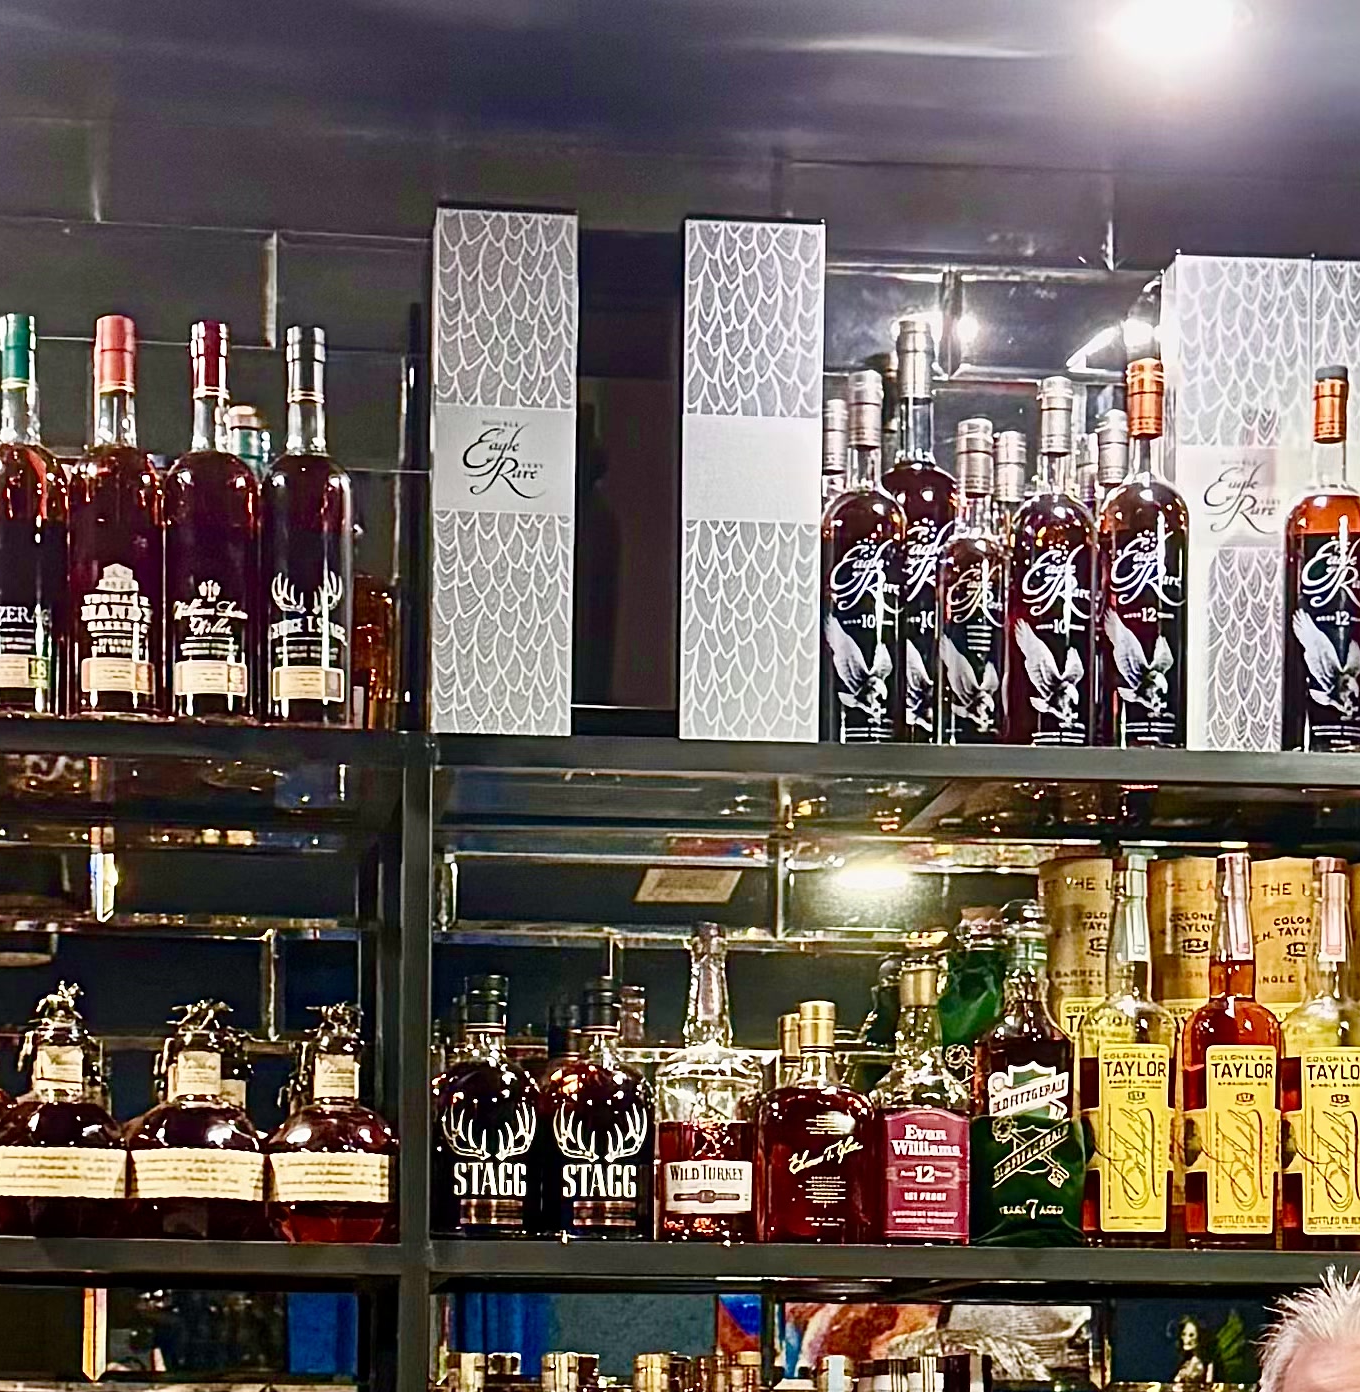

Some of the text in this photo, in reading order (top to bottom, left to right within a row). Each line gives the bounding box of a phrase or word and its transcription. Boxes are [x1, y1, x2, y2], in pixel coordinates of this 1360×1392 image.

[462, 422, 530, 477] Eagle
[470, 457, 546, 499] Rare
[1210, 495, 1279, 535] Rare
[860, 611, 877, 628] 10
[1140, 607, 1158, 623] 12
[1334, 610, 1350, 626] 12
[1261, 882, 1293, 897] THE
[1169, 911, 1216, 922] COLONE
[1081, 921, 1108, 931] TAYL
[1278, 926, 1312, 937] TAYL
[1258, 974, 1296, 985] INGLE
[1103, 1060, 1168, 1078] TAYLOR
[1210, 1062, 1273, 1079] TAYLOR
[904, 1124, 948, 1141] Evan
[891, 1140, 962, 1158] Williams
[453, 1162, 527, 1197] STAGG
[562, 1163, 637, 1199] STAGG
[670, 1163, 744, 1182] WILD TURKEY
[915, 1164, 935, 1184] 12
[1026, 1199, 1040, 1220] 7
